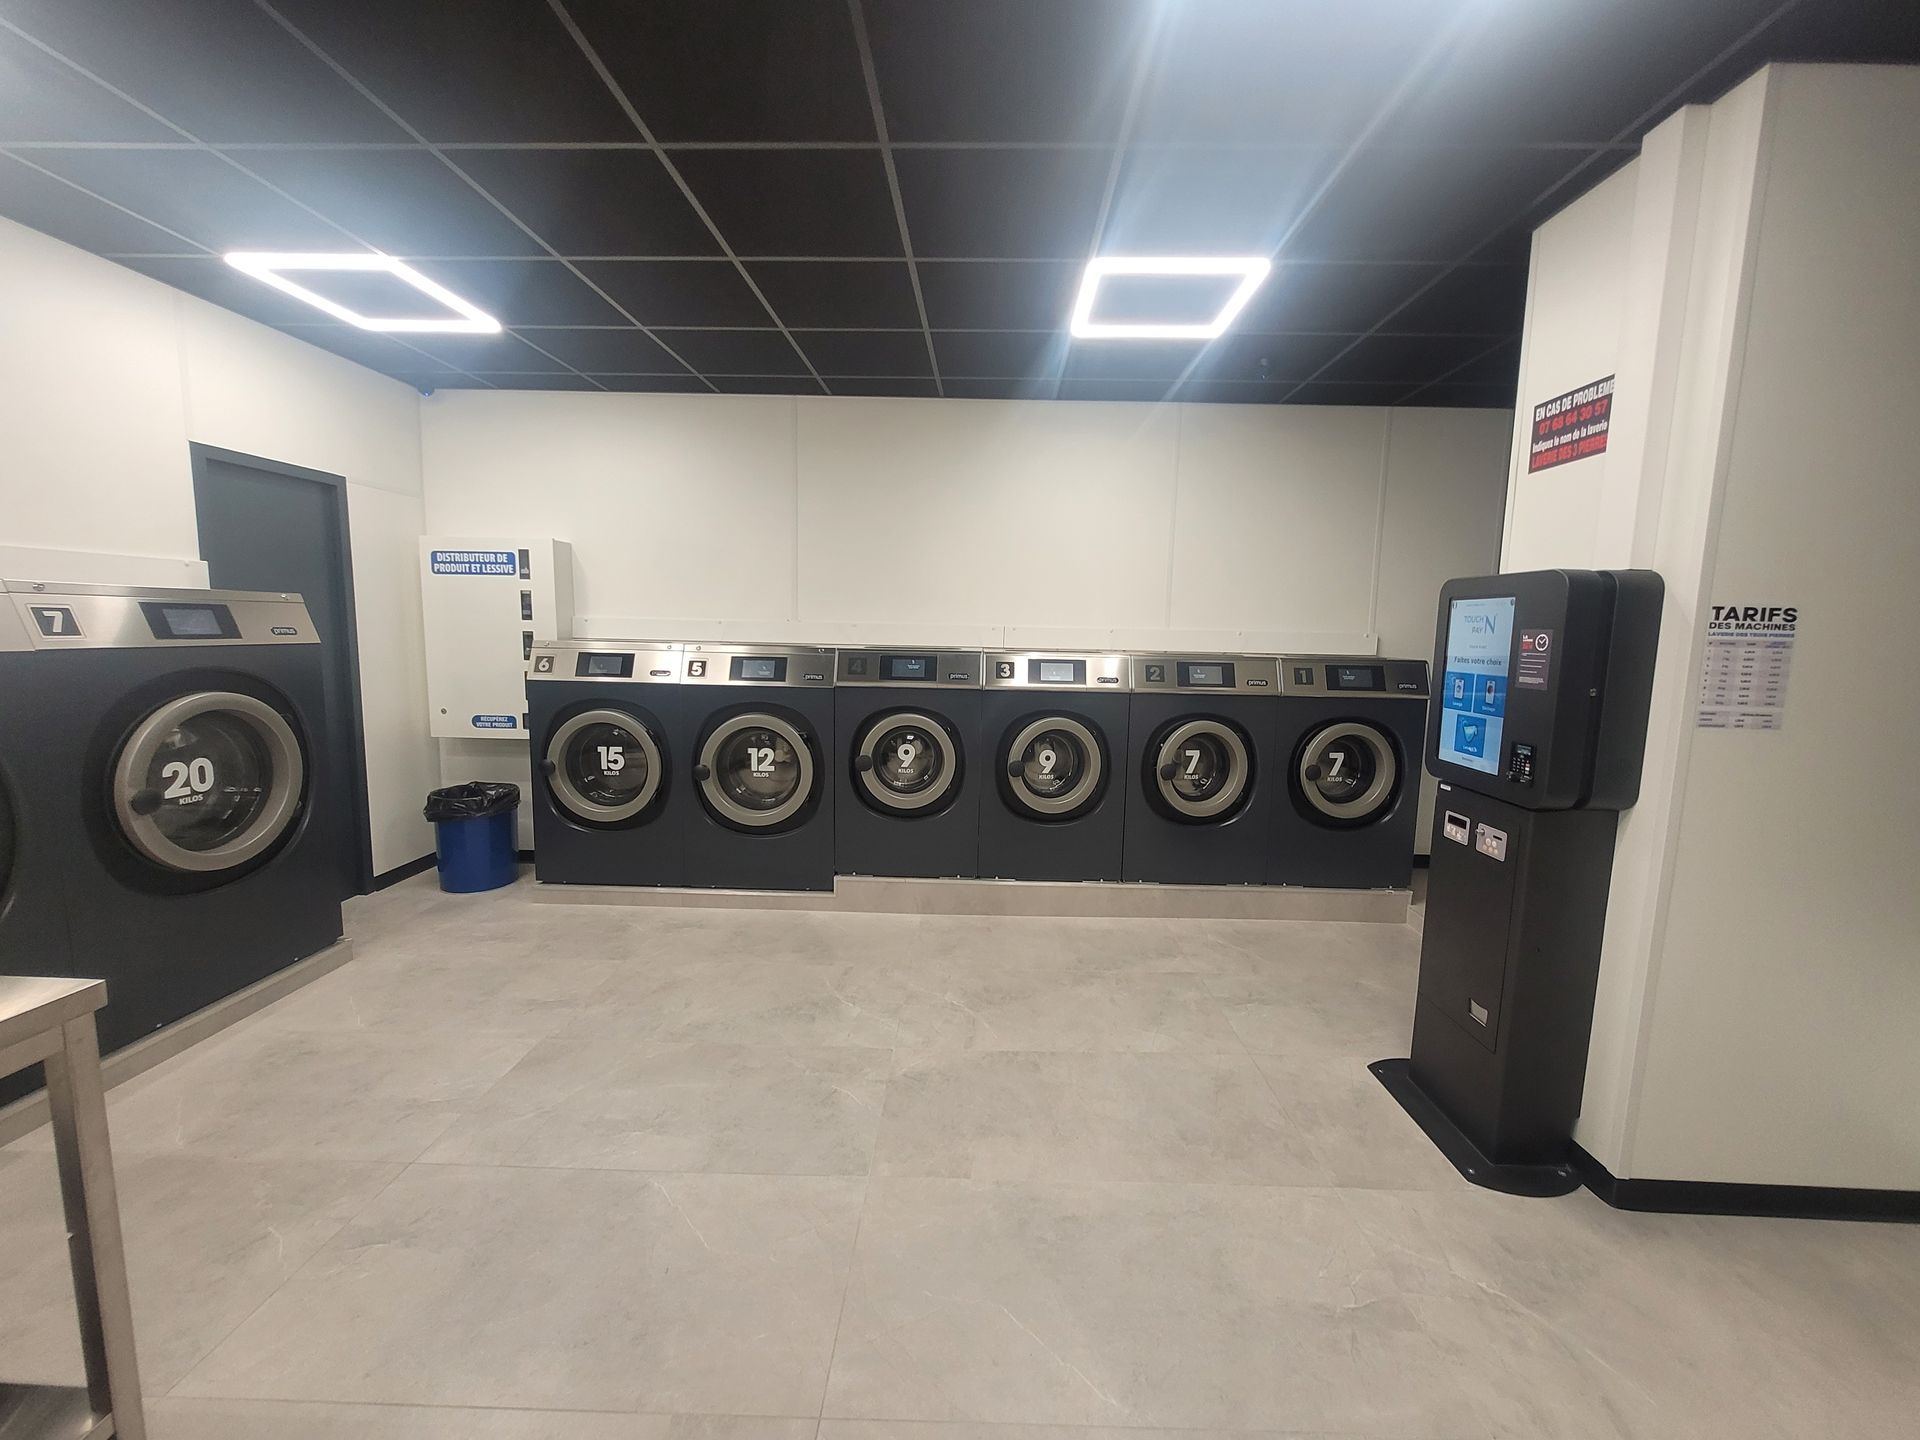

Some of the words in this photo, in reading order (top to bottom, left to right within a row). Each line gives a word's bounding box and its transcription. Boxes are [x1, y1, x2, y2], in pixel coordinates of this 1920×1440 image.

[1536, 408, 1545, 422] EN
[1546, 400, 1560, 417] CAS
[1562, 395, 1573, 411] DE
[1573, 379, 1615, 406] PROBLEME
[1554, 435, 1559, 445] le
[1560, 433, 1571, 445] nom
[1573, 430, 1580, 441] de
[1580, 426, 1587, 438] la
[1587, 420, 1608, 435] laverie
[436, 552, 496, 563] DISTRIBUTEUR
[497, 553, 508, 563] DE
[434, 563, 470, 573] PRODUIT
[471, 563, 481, 573] ET
[482, 564, 514, 574] LESSIVE
[41, 610, 64, 633] 7
[1712, 606, 1798, 623] TARIFS
[1464, 615, 1484, 624] TOUCH
[1485, 615, 1497, 635] N
[1472, 626, 1483, 634] PAY
[1709, 622, 1731, 630] DES
[1735, 622, 1796, 632] MACHINES
[538, 657, 550, 672] 6
[690, 662, 703, 676] 5
[1454, 656, 1470, 664] Faites
[1486, 658, 1502, 666] choix
[1000, 663, 1011, 677] 3
[1149, 666, 1161, 680] 2
[1299, 669, 1307, 683] 1
[597, 746, 625, 771] 15
[747, 748, 775, 772] 12
[897, 743, 916, 768] 9
[1038, 749, 1057, 774] 9
[1185, 750, 1200, 774] 7
[1328, 752, 1345, 776] 7
[162, 757, 215, 799] 20
[179, 794, 204, 806] KILOS
